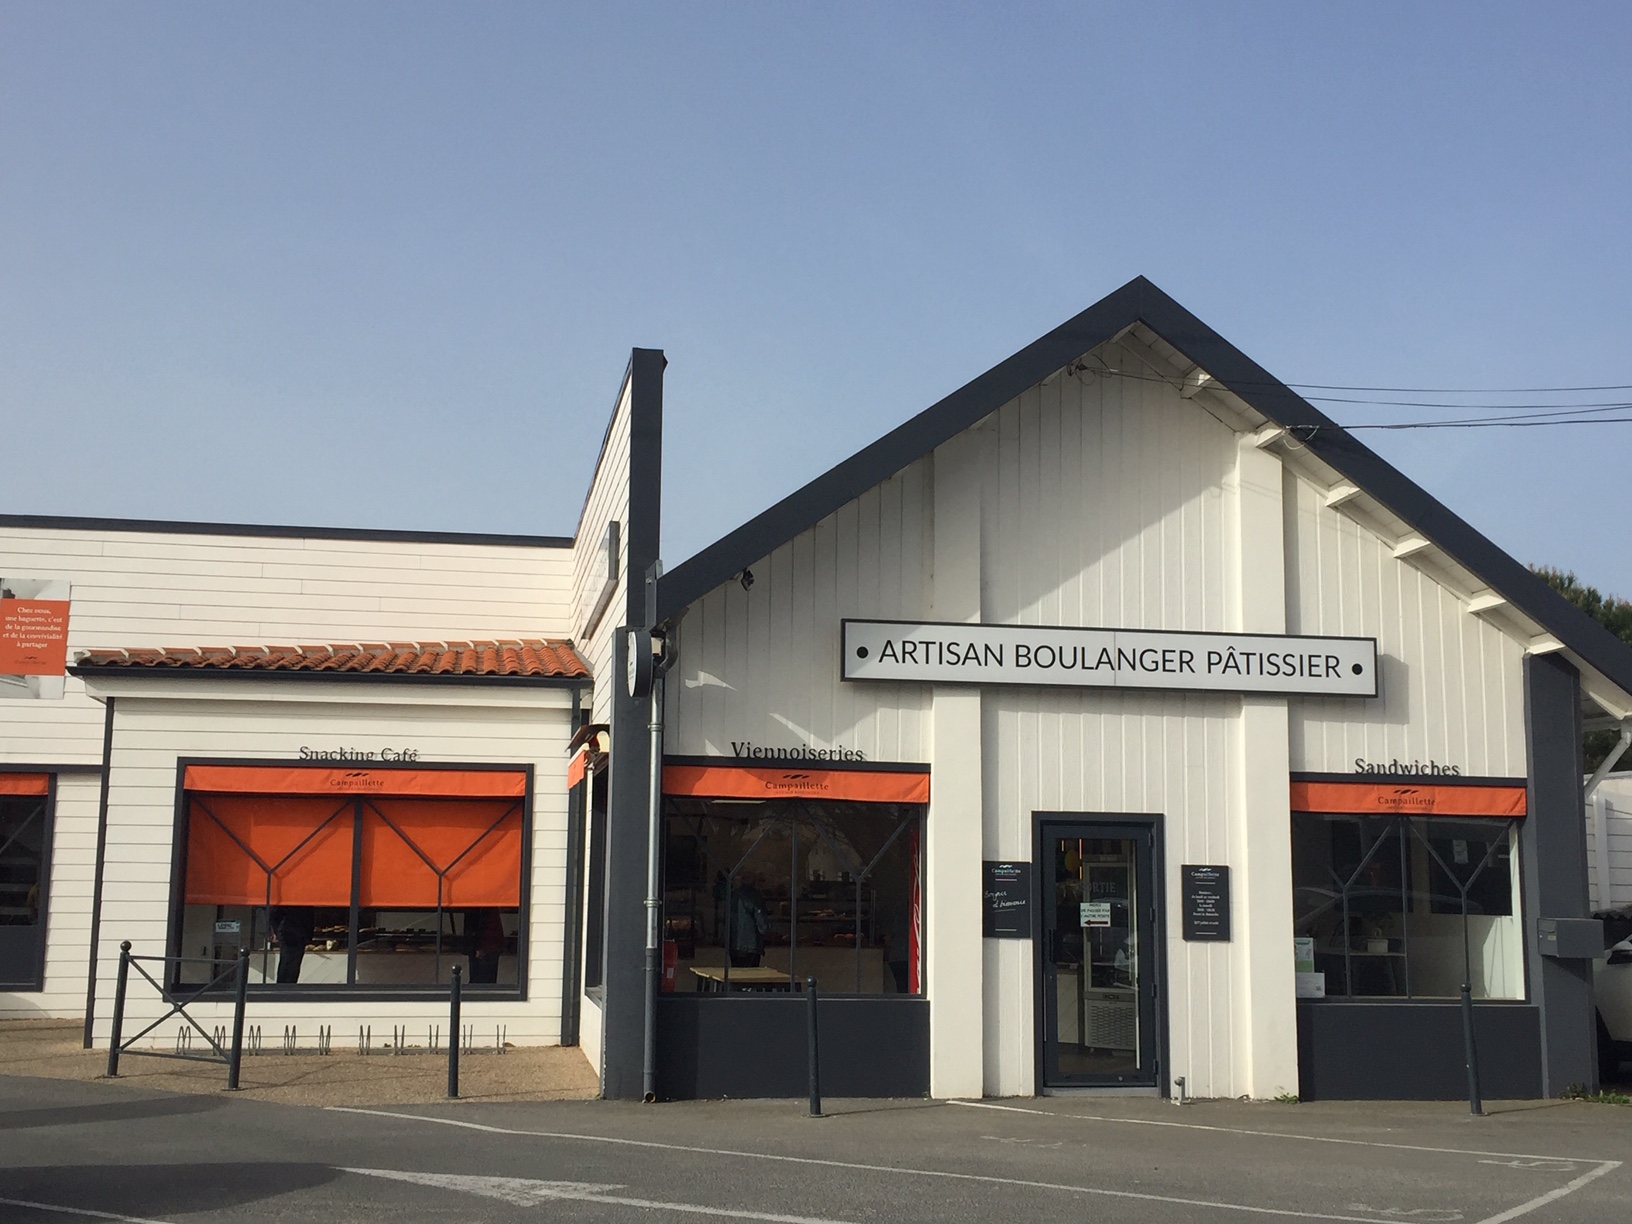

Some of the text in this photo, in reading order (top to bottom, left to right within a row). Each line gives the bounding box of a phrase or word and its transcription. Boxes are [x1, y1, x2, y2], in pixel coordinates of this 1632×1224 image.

[18, 615, 47, 623] baguette,
[878, 639, 1342, 679] ARTISAN BOULANGER PÂTISSIER
[299, 746, 419, 762] Snacking Café
[730, 741, 865, 761] Viennoiseries
[1354, 757, 1461, 776] Sandwiches
[329, 779, 385, 788] Campaillette
[765, 781, 829, 791] Campaillette
[1377, 796, 1436, 806] Campaillette
